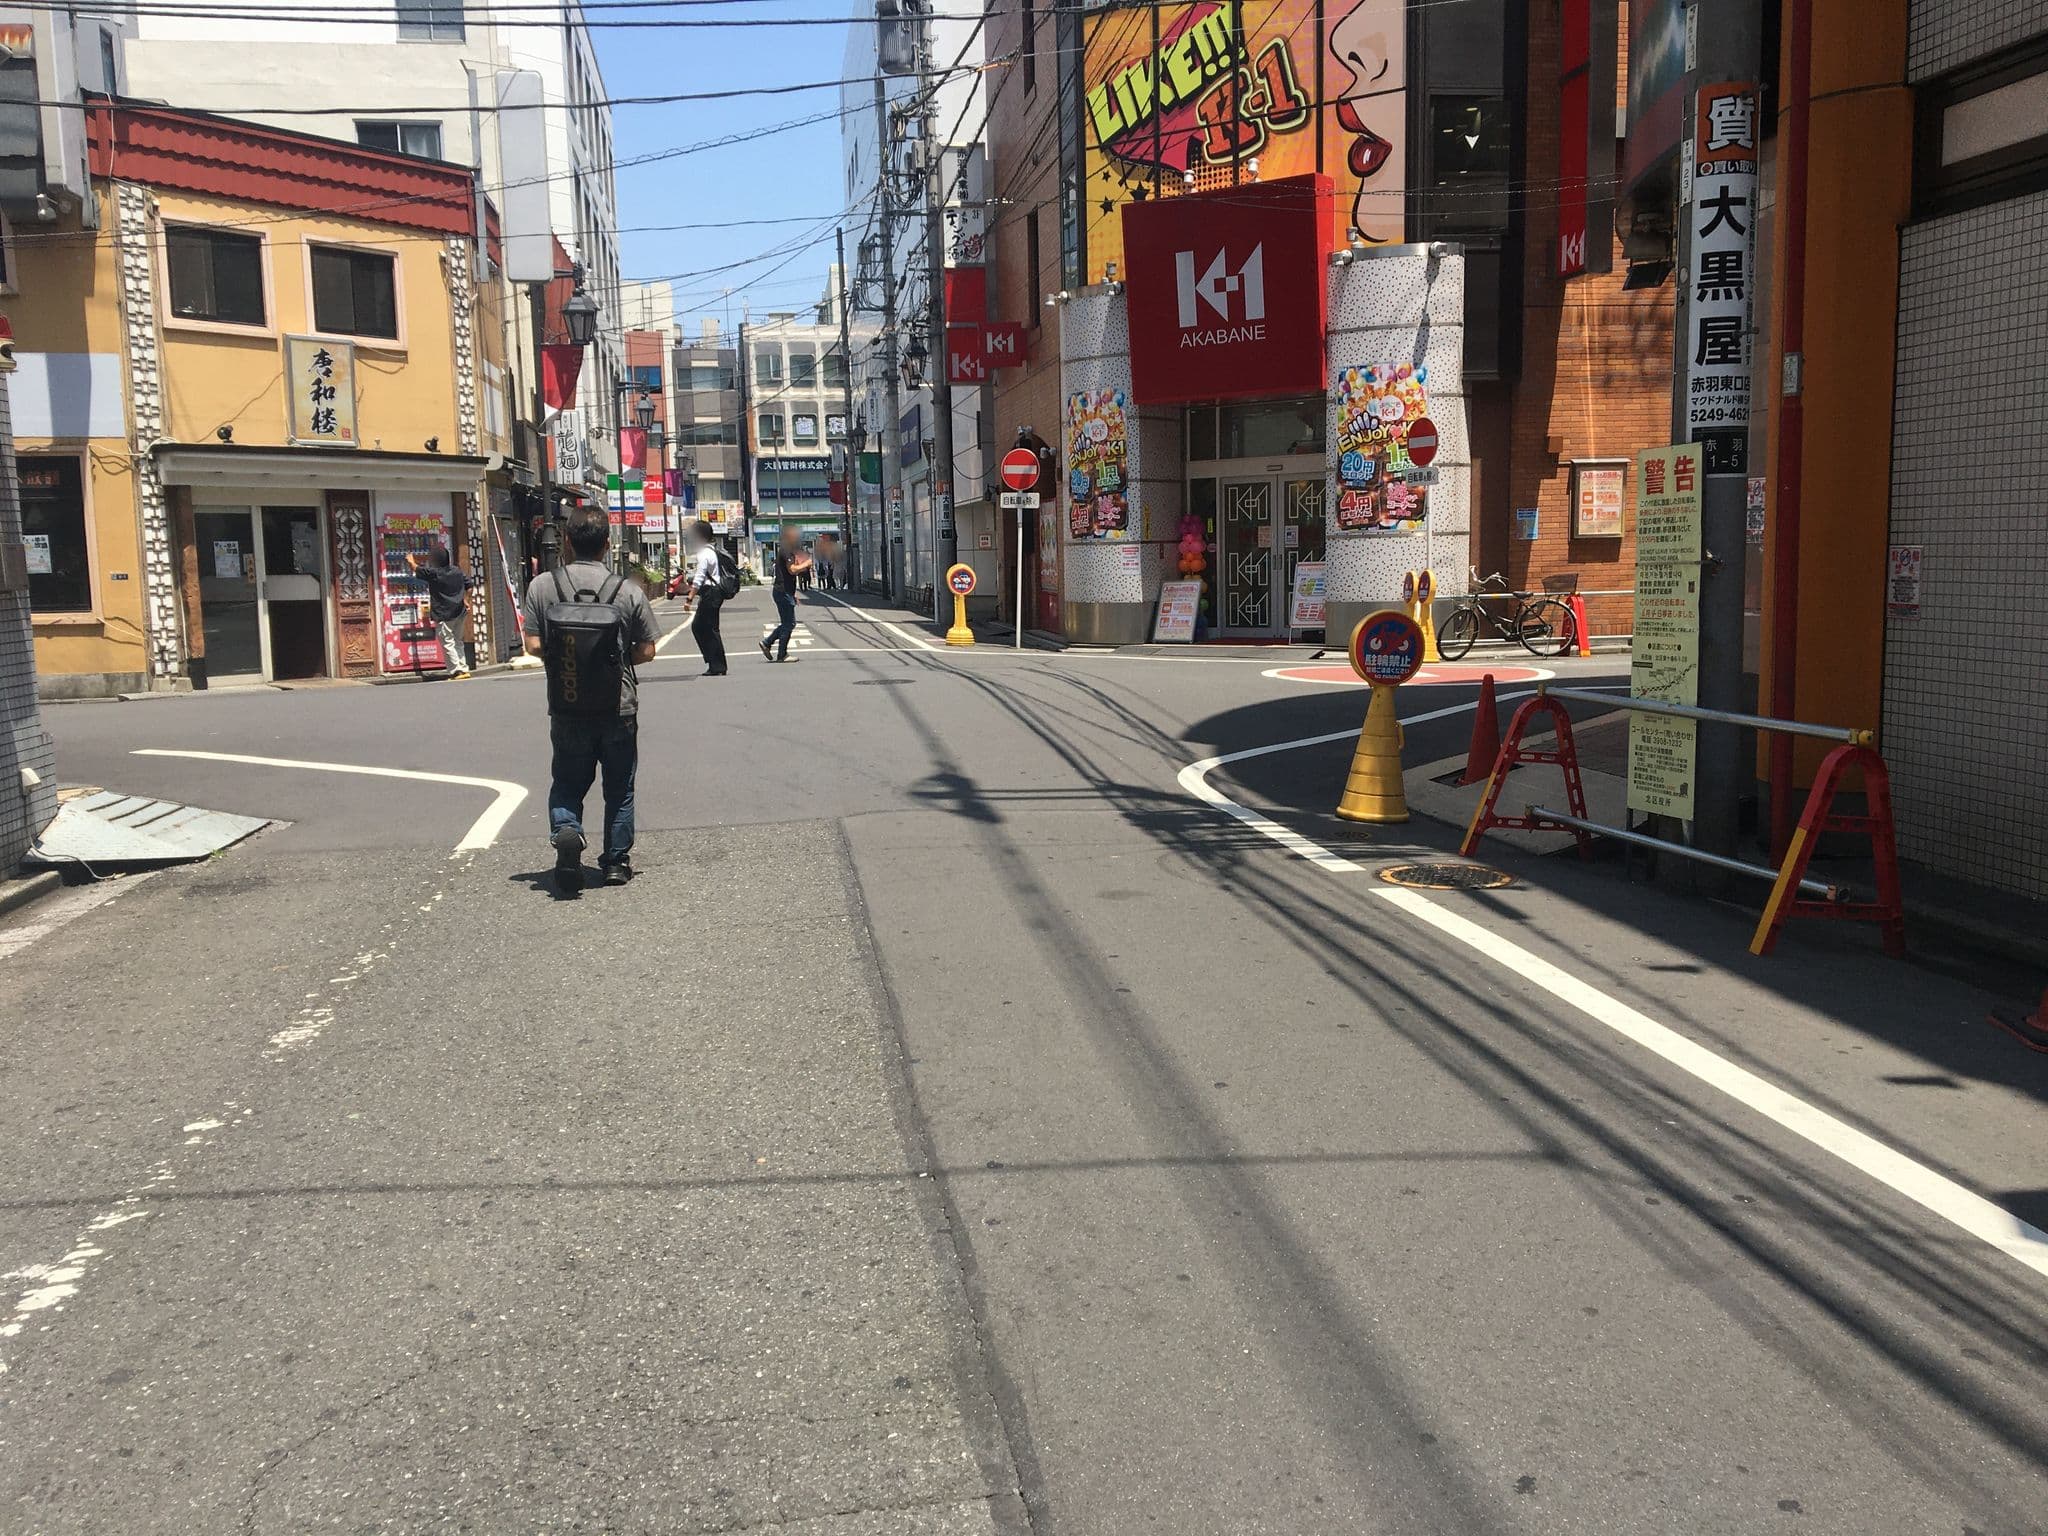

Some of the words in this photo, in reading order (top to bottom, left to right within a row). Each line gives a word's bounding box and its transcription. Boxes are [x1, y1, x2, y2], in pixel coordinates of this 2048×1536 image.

[1197, 37, 1307, 163] K-1
[1707, 96, 1755, 151] 質
[1175, 241, 1265, 328] K-1
[1695, 185, 1747, 366] 大黒屋
[987, 327, 1014, 354] K-1
[1180, 324, 1266, 349] AKABANE
[1337, 423, 1391, 453] ENJOY
[1069, 444, 1099, 469] ENJOY
[1106, 440, 1126, 457] K-1
[1710, 454, 1739, 468] 1-5
[1645, 454, 1696, 495] 警告
[1340, 490, 1372, 511] 4円
[562, 633, 577, 703] adidas
[1365, 654, 1411, 667] 駐輪禁止
[1645, 794, 1672, 807] 北区役所
